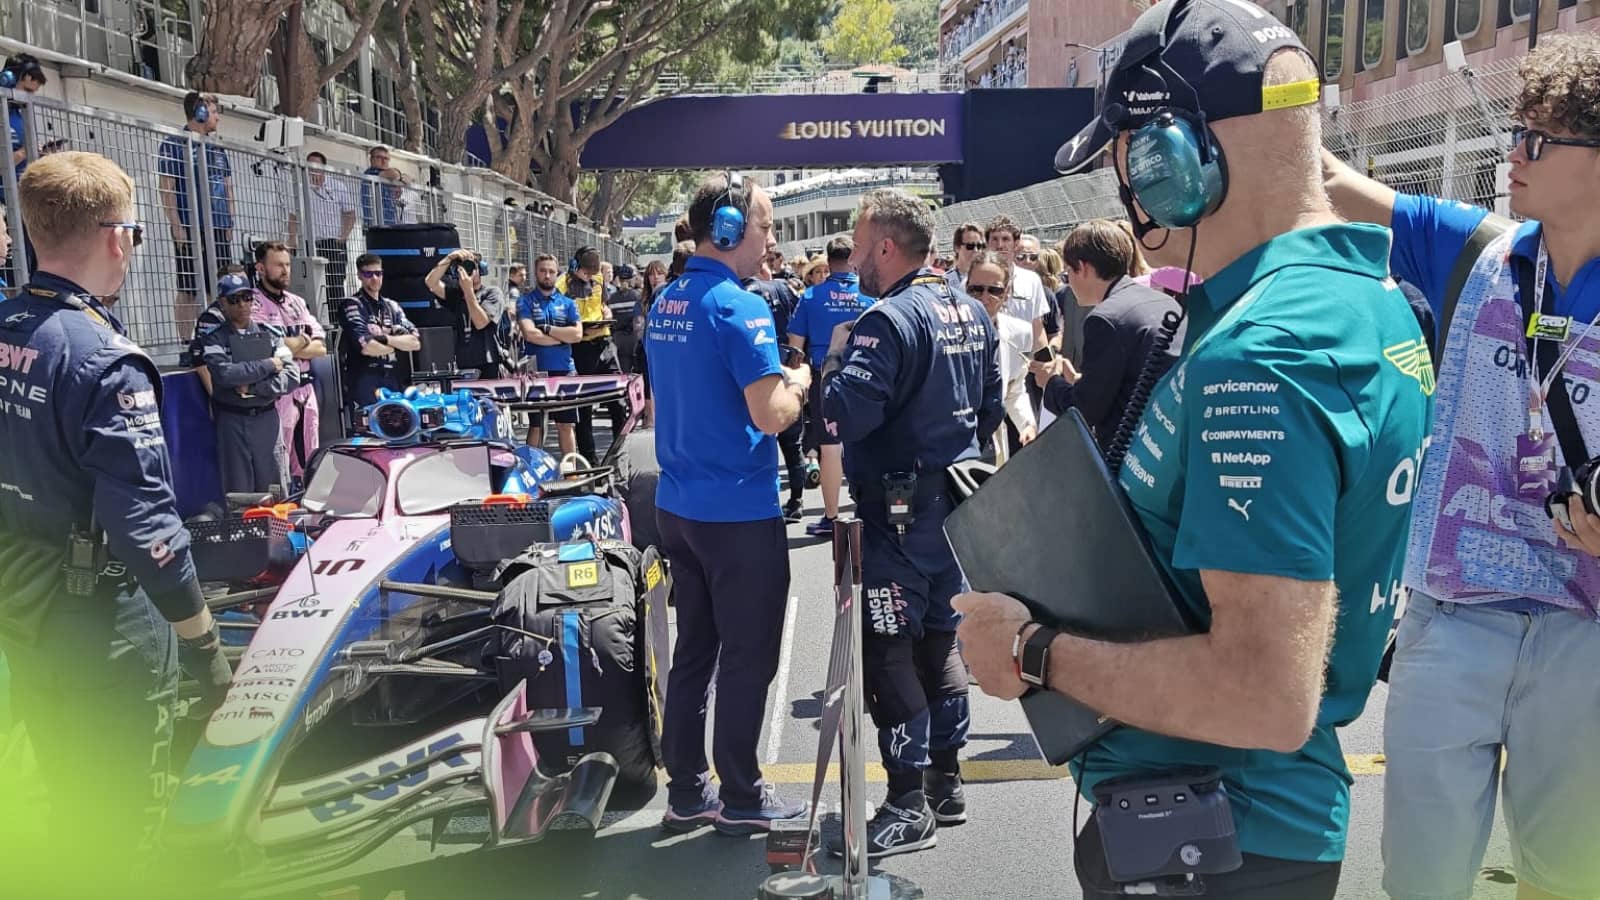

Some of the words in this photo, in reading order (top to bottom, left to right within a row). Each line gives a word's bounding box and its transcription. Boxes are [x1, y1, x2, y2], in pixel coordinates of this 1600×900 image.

[790, 120, 852, 140] LOUIS
[856, 118, 946, 138] VUITTON
[1130, 154, 1162, 175] aramco
[667, 300, 690, 316] BWT
[648, 320, 695, 331] ALPINE
[936, 324, 985, 342] ALPNE
[1203, 379, 1279, 395] servicenow
[1215, 405, 1280, 416] BREITLING
[1208, 429, 1285, 441] COINPAYMENTS
[1222, 452, 1272, 466] NetApp
[584, 510, 616, 541] MSC
[313, 558, 367, 577] 10
[574, 566, 593, 581] R6
[271, 608, 334, 620] BWT
[251, 648, 304, 658] CATO
[242, 692, 289, 702] MSC
[212, 706, 245, 722] eni
